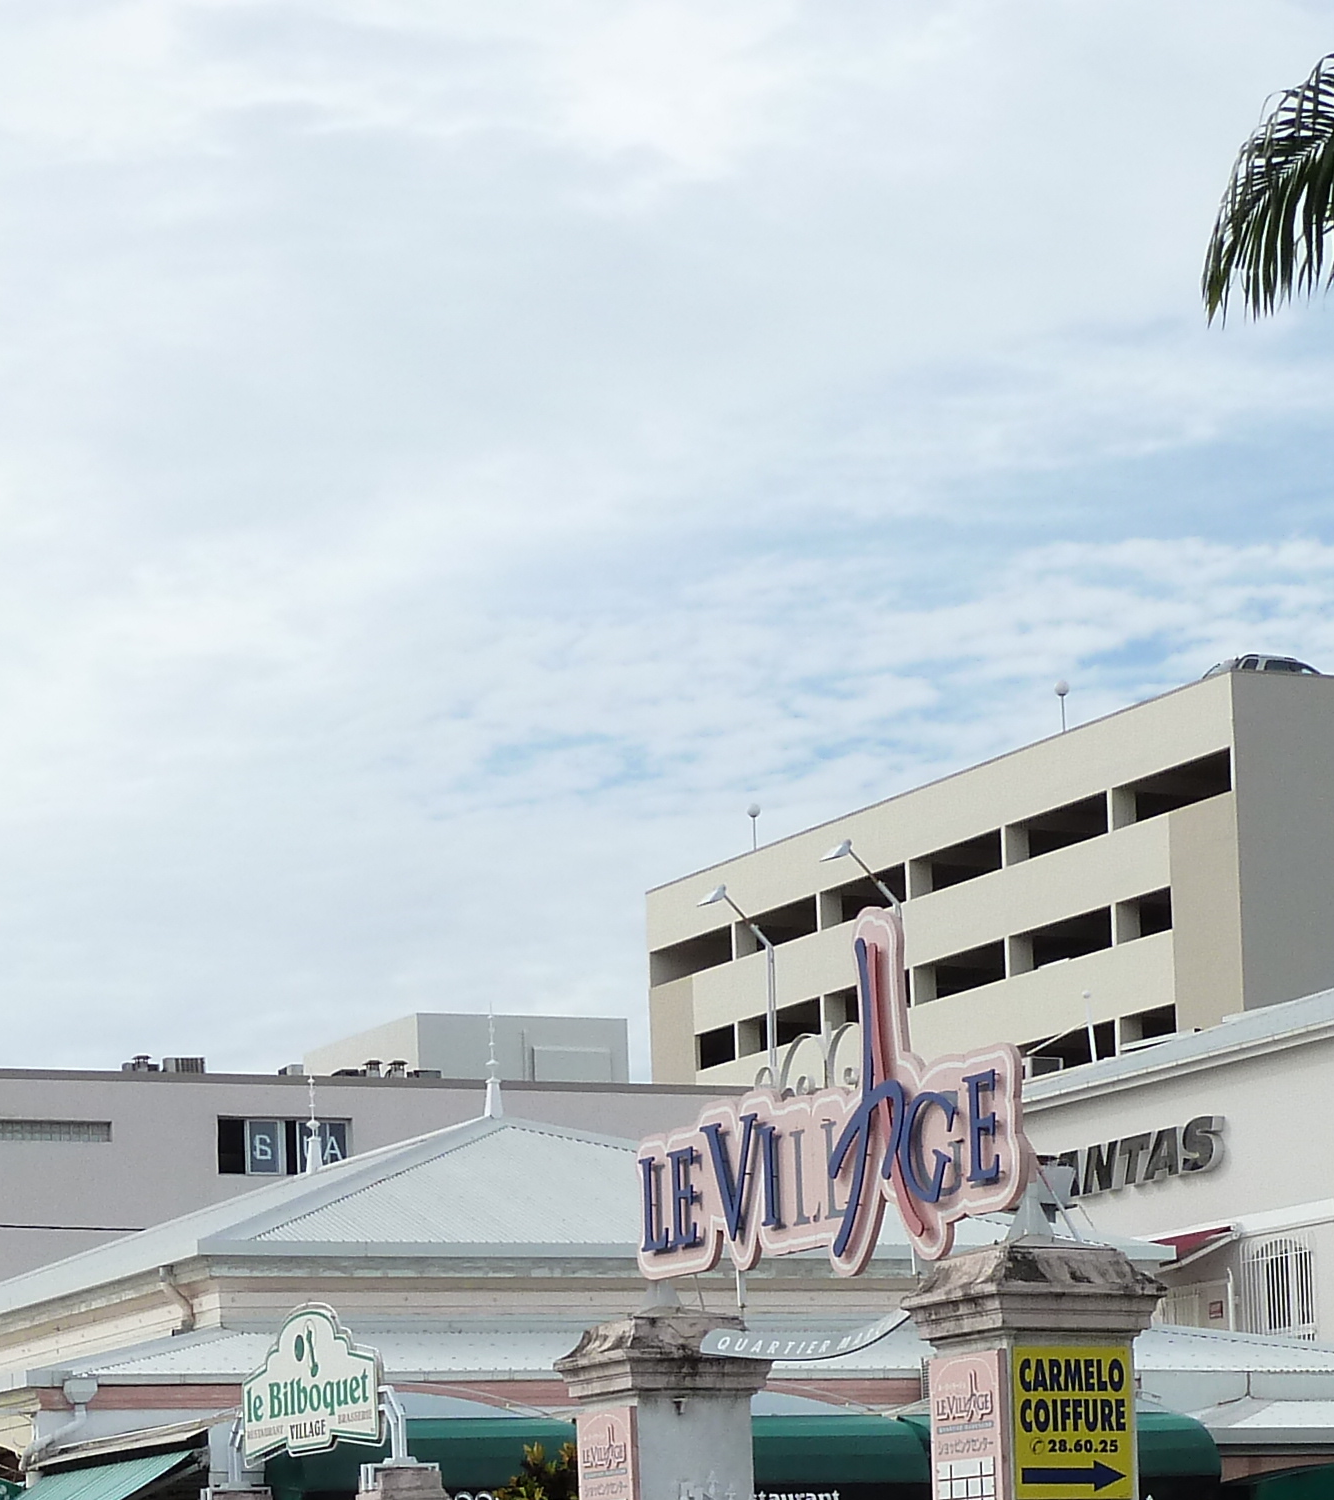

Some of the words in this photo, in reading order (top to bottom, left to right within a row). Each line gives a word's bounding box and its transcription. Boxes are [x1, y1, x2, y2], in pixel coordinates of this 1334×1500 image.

[638, 1145, 703, 1254] LE
[717, 1336, 832, 1356] QUARTIER
[1019, 1358, 1125, 1392] CARMELO
[246, 1386, 264, 1423] le
[268, 1368, 370, 1420] Bilboquet
[289, 1419, 326, 1441] VILLAGE
[1020, 1398, 1127, 1433] COIFFURE
[1047, 1439, 1119, 1453] 28.60.25
